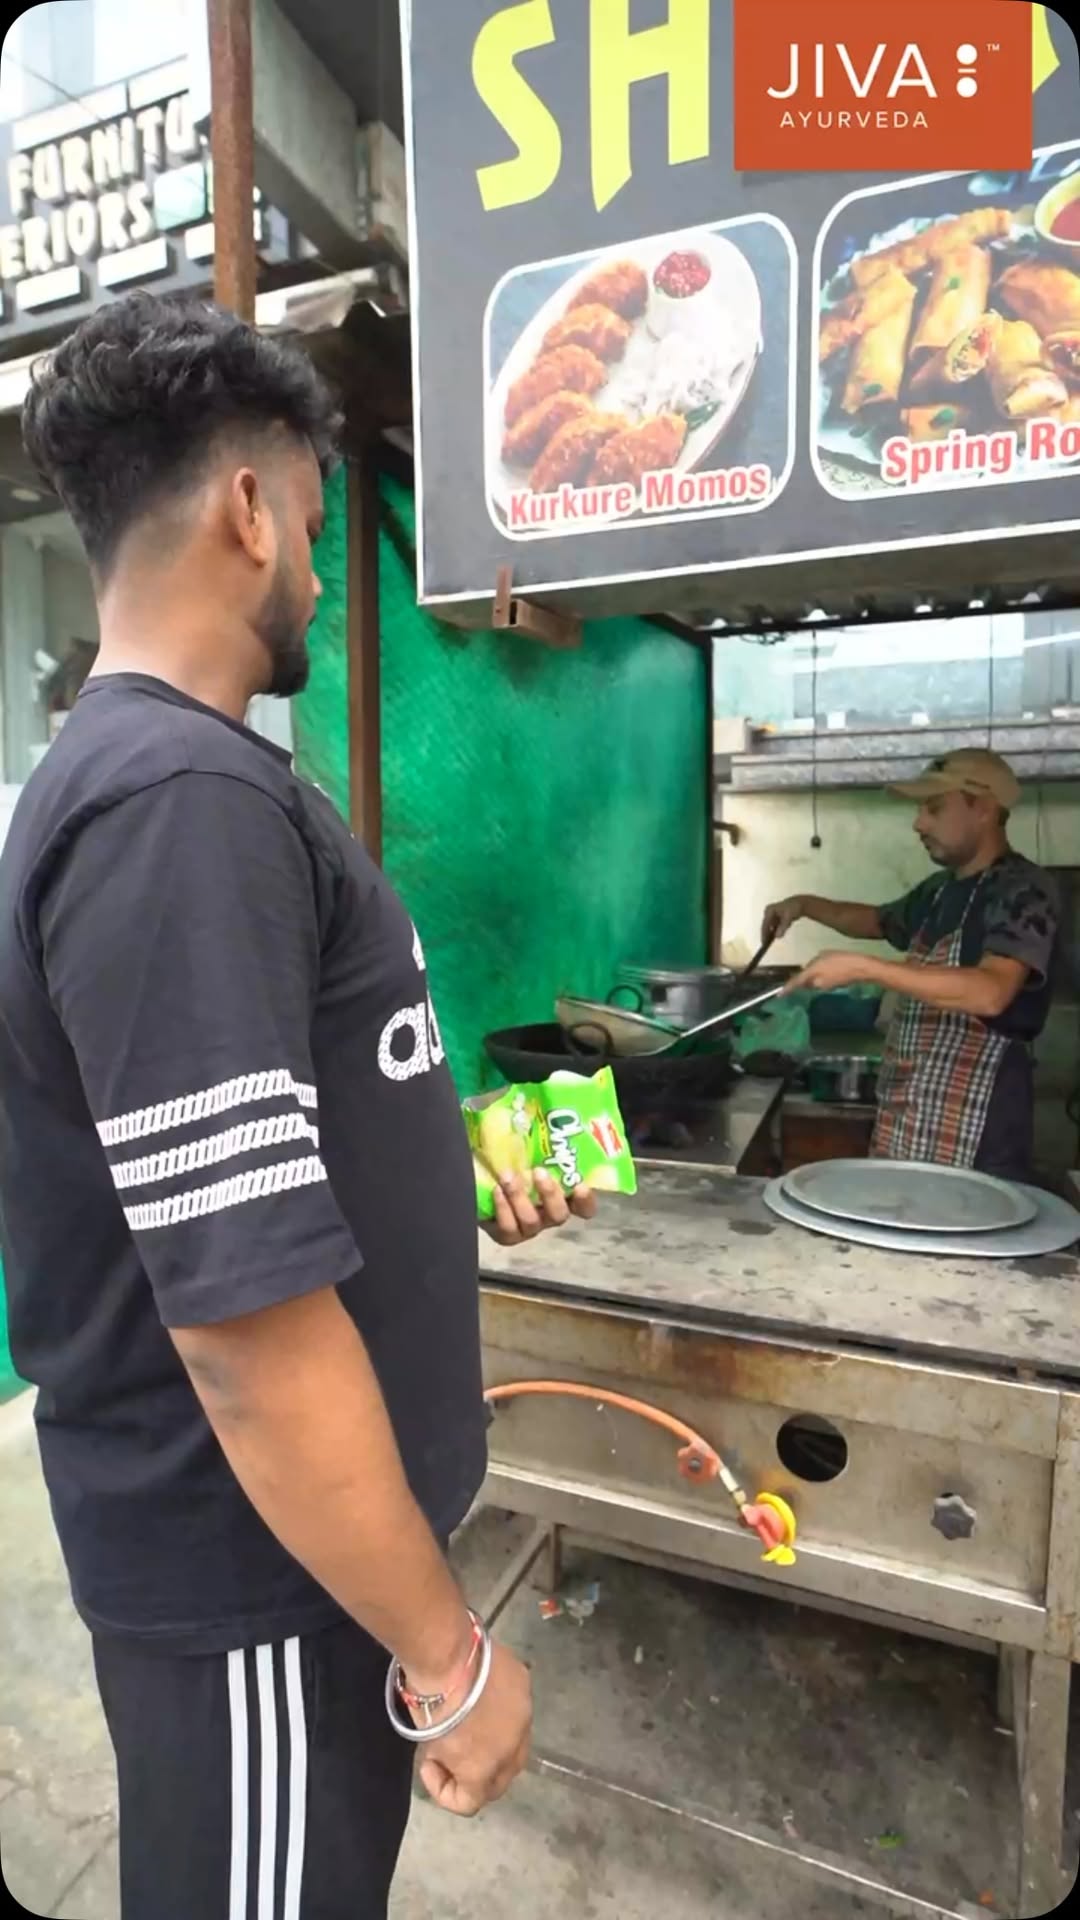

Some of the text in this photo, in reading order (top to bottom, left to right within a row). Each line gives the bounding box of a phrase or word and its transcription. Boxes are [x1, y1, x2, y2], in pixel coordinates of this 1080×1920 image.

[8, 96, 208, 217] FURNITU
[885, 434, 1013, 484] Spring
[509, 466, 768, 526] Kurkure Momos
[544, 1109, 582, 1187] Chips
